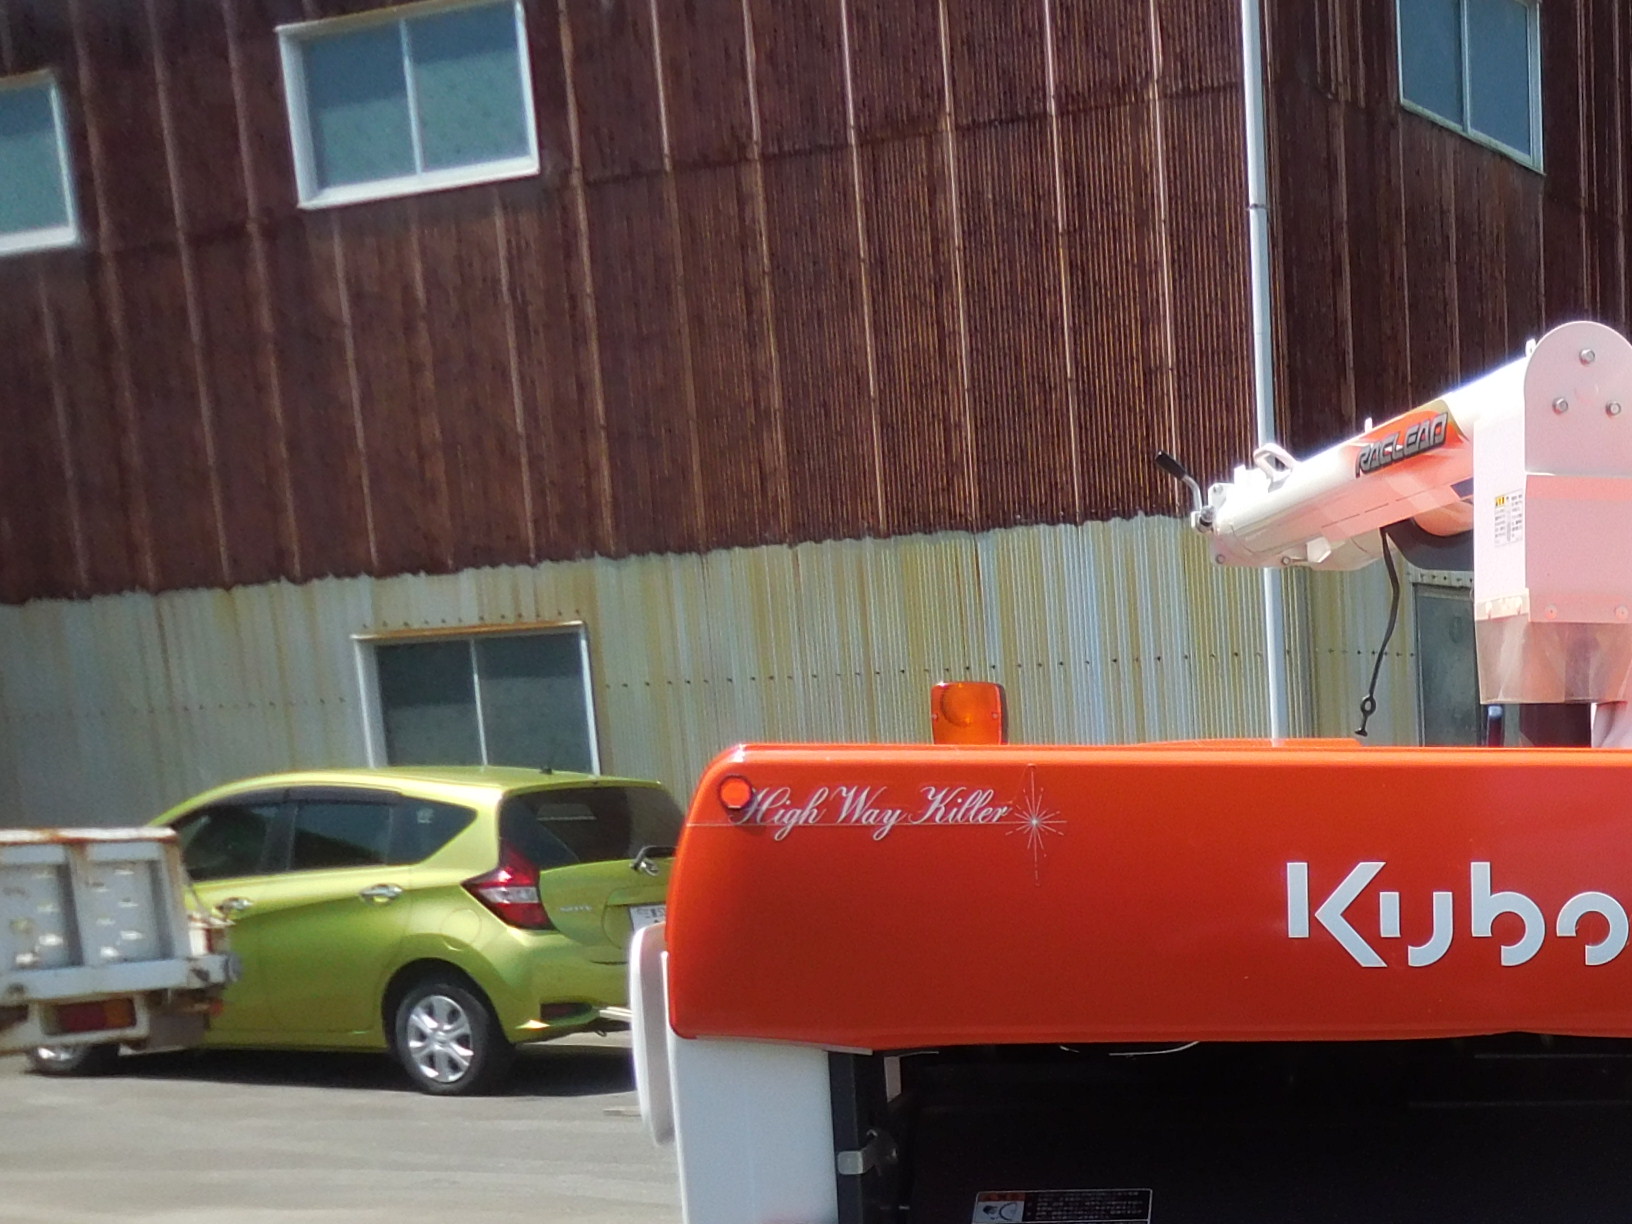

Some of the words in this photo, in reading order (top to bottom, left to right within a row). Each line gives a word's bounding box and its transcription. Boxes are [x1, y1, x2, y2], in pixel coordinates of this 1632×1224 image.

[735, 785, 827, 841] High
[830, 785, 908, 841] Way
[908, 786, 1014, 824] Killer
